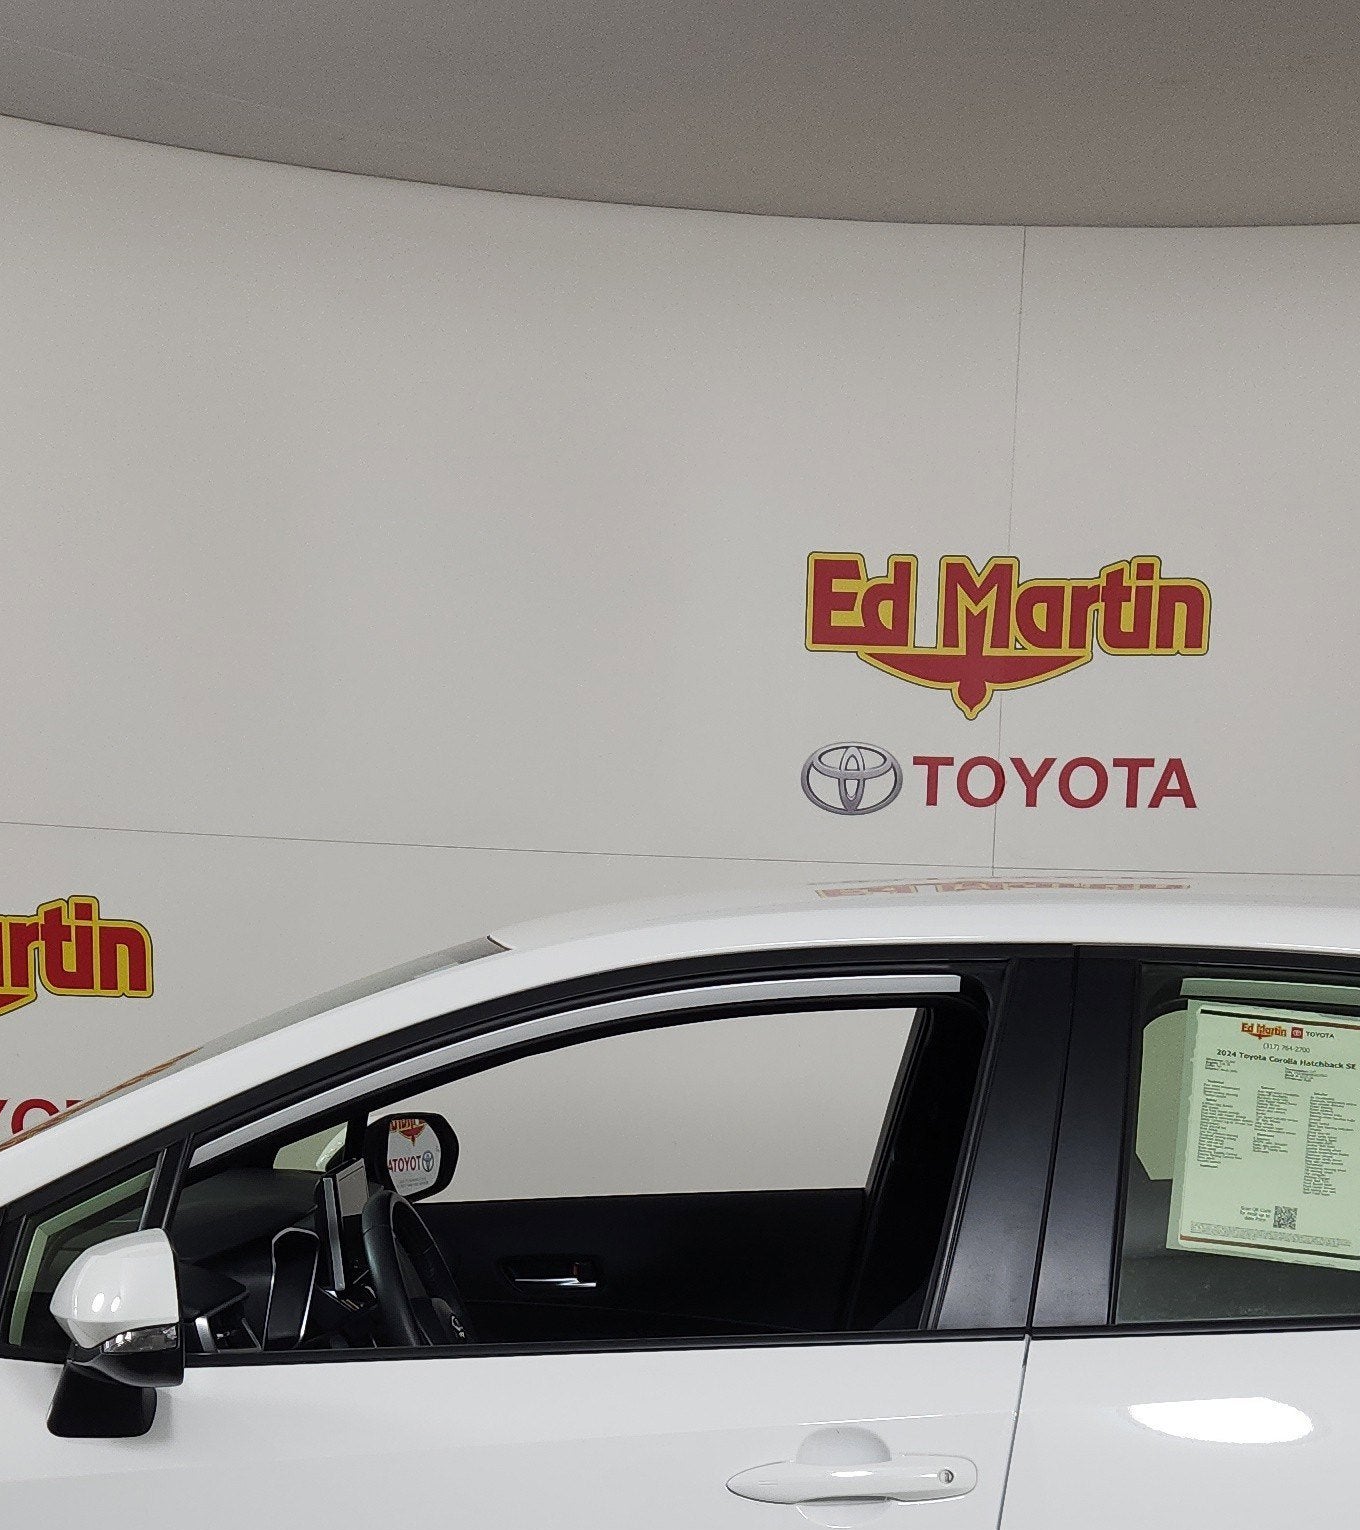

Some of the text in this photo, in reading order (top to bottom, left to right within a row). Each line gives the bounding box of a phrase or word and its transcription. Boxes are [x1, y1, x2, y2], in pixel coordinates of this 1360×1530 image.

[805, 551, 1212, 656] Ed Martin
[912, 755, 1198, 810] TOYOTA
[1305, 1030, 1335, 1039] TOYOTA
[1216, 1048, 1237, 1058] 2024
[1238, 1051, 1267, 1062] Toyota
[1268, 1055, 1298, 1066] Corolla
[1299, 1058, 1344, 1070] Hatchback
